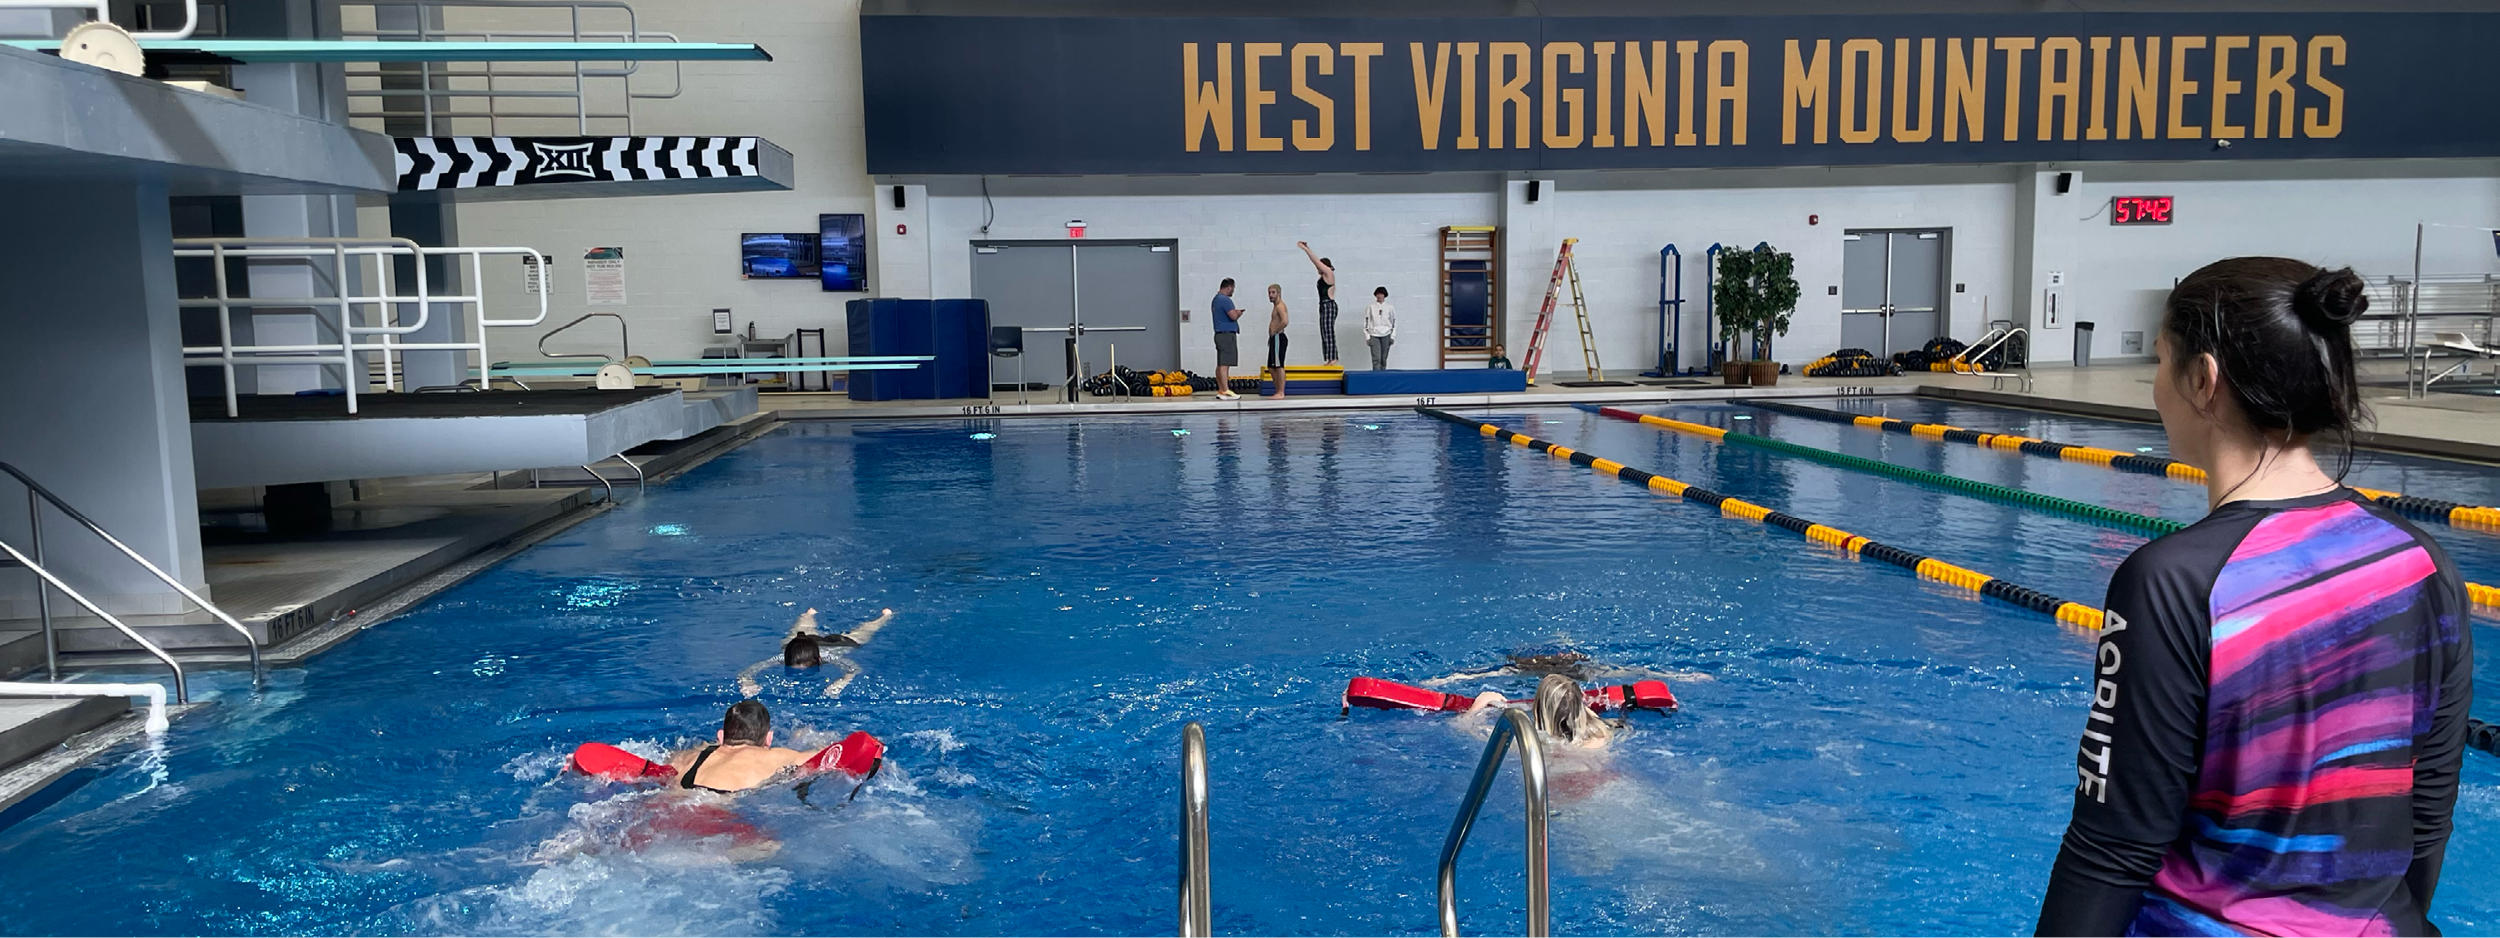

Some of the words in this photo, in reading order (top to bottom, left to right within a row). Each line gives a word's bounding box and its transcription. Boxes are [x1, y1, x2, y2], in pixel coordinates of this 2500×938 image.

[1183, 42, 1384, 152] WEST
[1410, 39, 1749, 150] VIRGINIA
[1782, 35, 2347, 145] MOUNTAINEERS
[536, 144, 594, 176] XII
[2116, 197, 2171, 223] 57:42
[1416, 397, 1425, 405] 16
[1427, 397, 1436, 405] FT
[1837, 386, 1845, 395] 15
[1847, 386, 1857, 395] FT
[962, 406, 971, 414] 16
[973, 406, 982, 414] FT
[985, 405, 990, 414] 6
[992, 405, 1000, 414] IN
[272, 617, 283, 640] 16
[285, 612, 295, 635] FT
[298, 609, 304, 629] 6
[305, 605, 314, 626] IN
